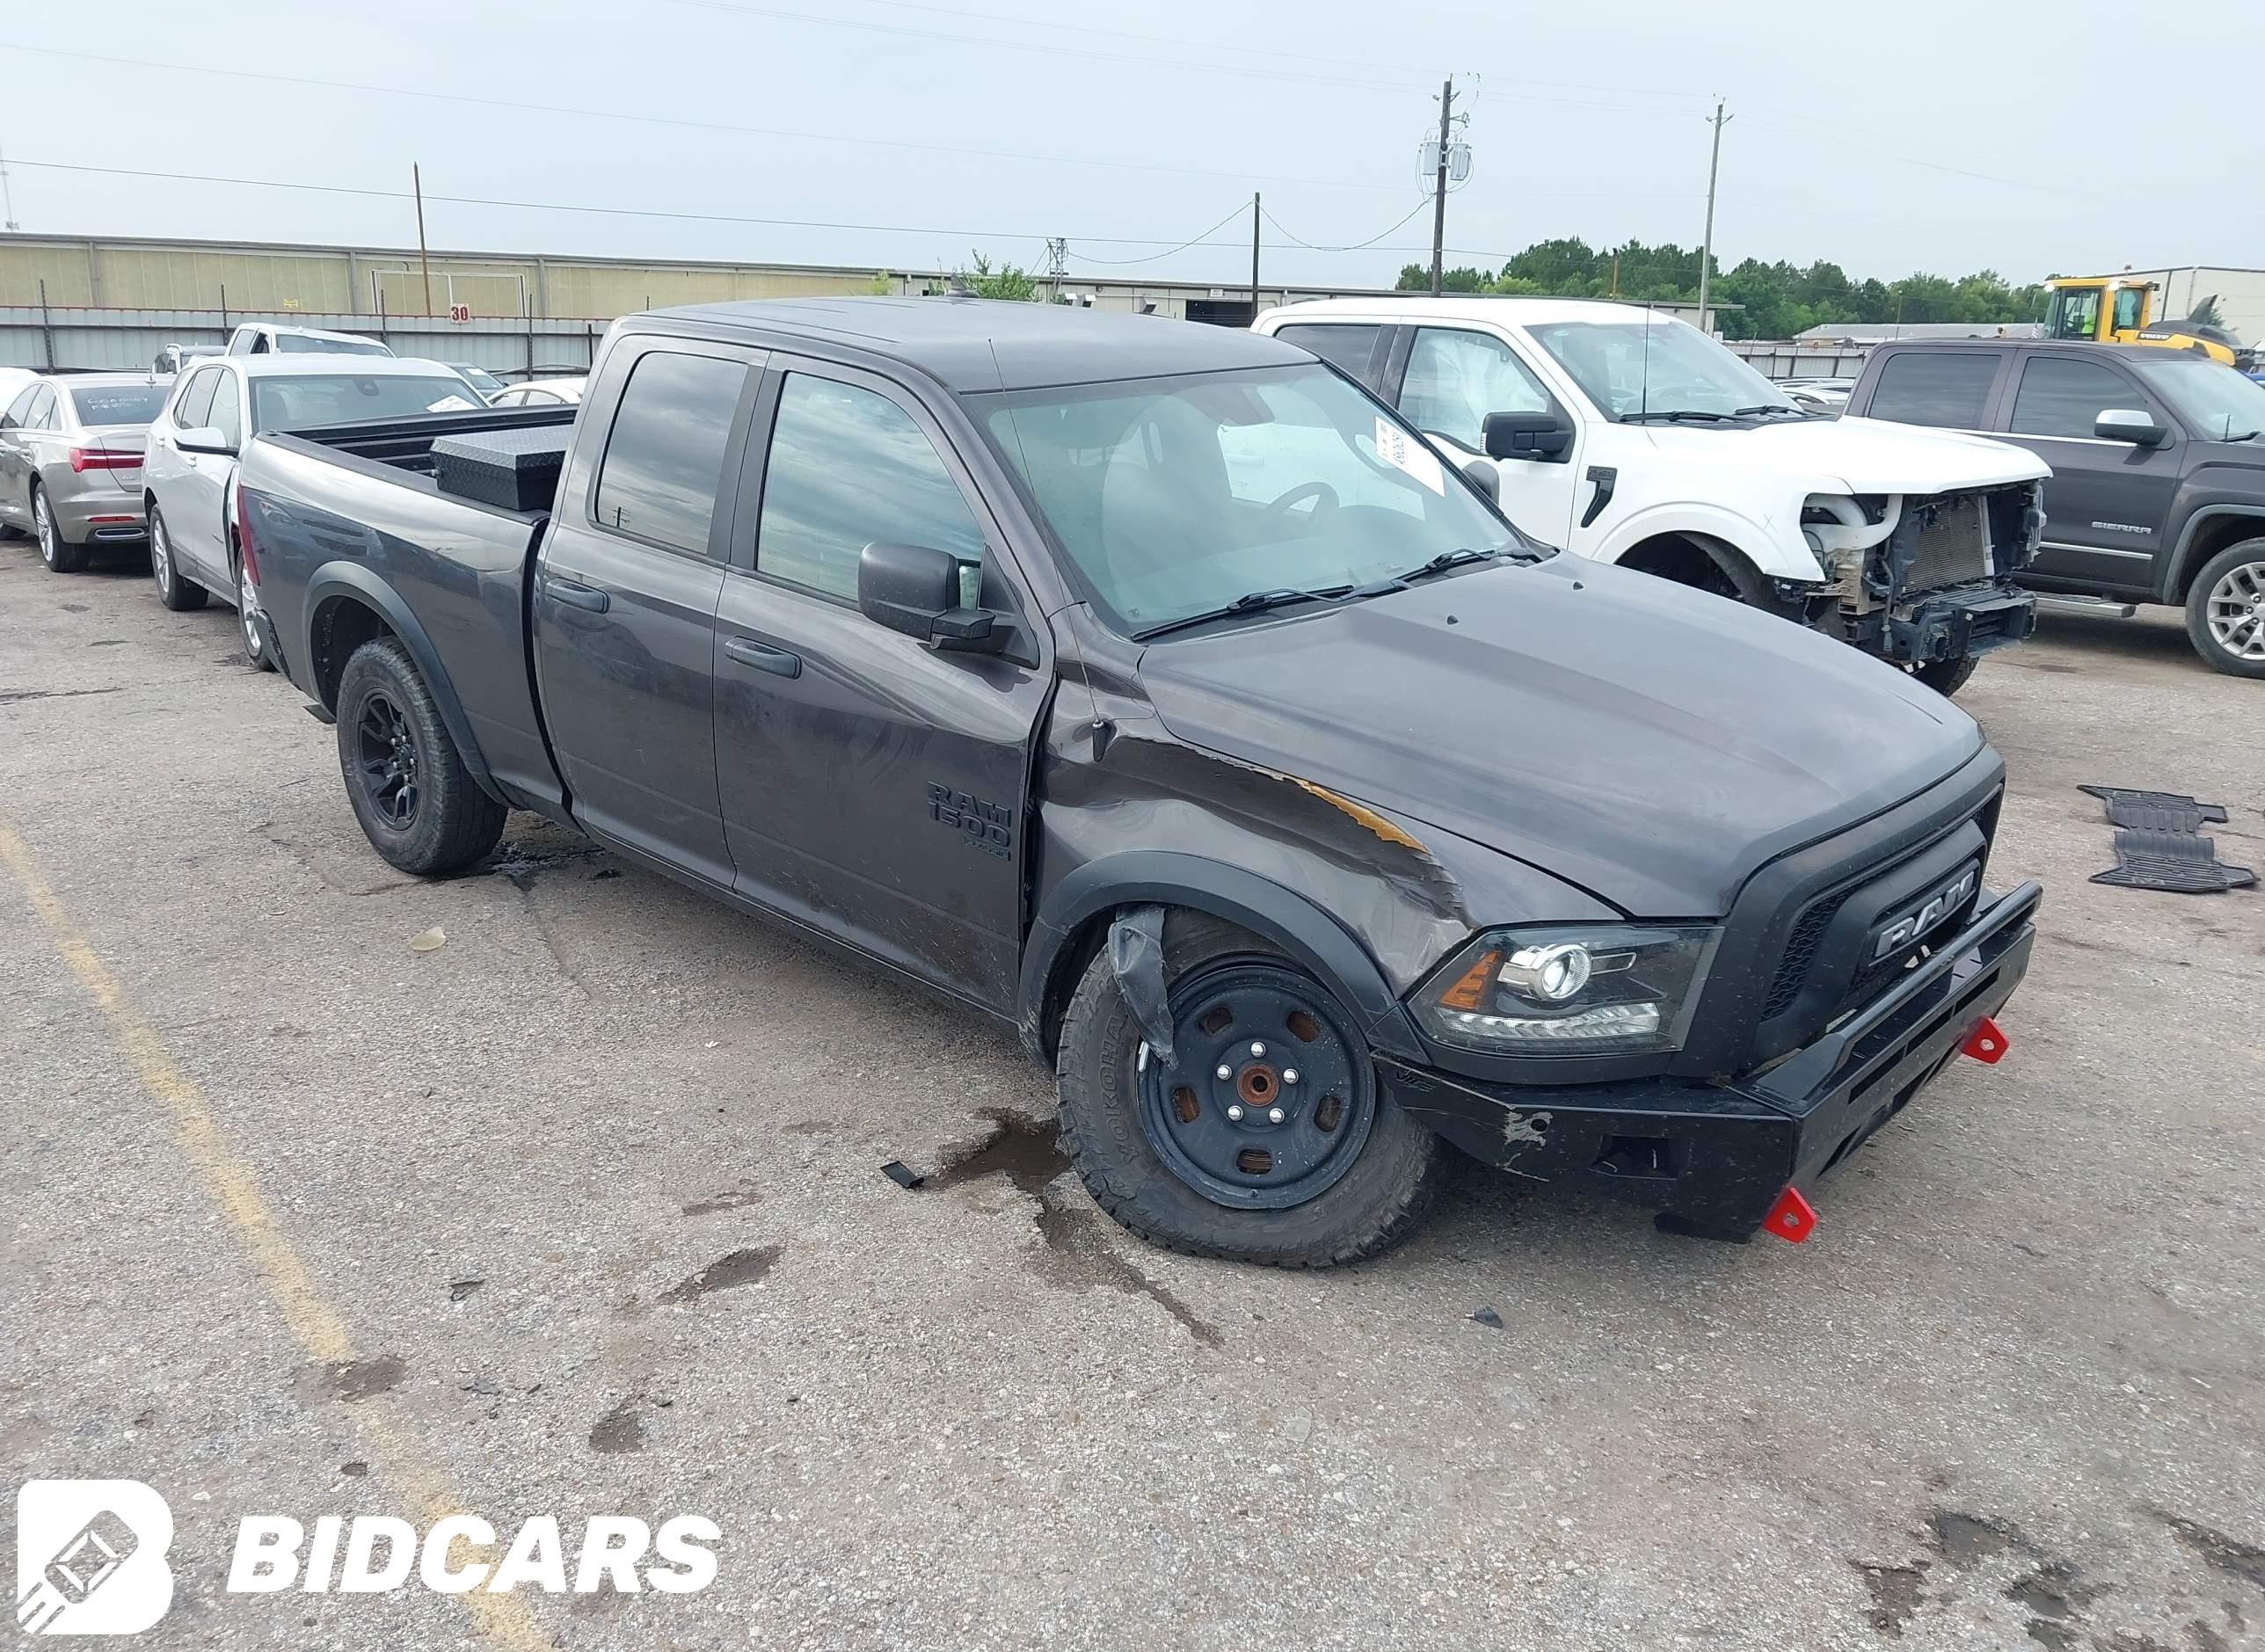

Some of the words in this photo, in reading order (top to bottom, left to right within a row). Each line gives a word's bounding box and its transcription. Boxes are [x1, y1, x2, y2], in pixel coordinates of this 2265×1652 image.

[450, 306, 469, 321] 30
[2091, 520, 2153, 535] SIERRA
[928, 781, 1011, 828] RAM
[928, 801, 1011, 848] 1500
[1874, 870, 1975, 957] RAM
[1100, 1001, 1140, 1164] YOKOHA
